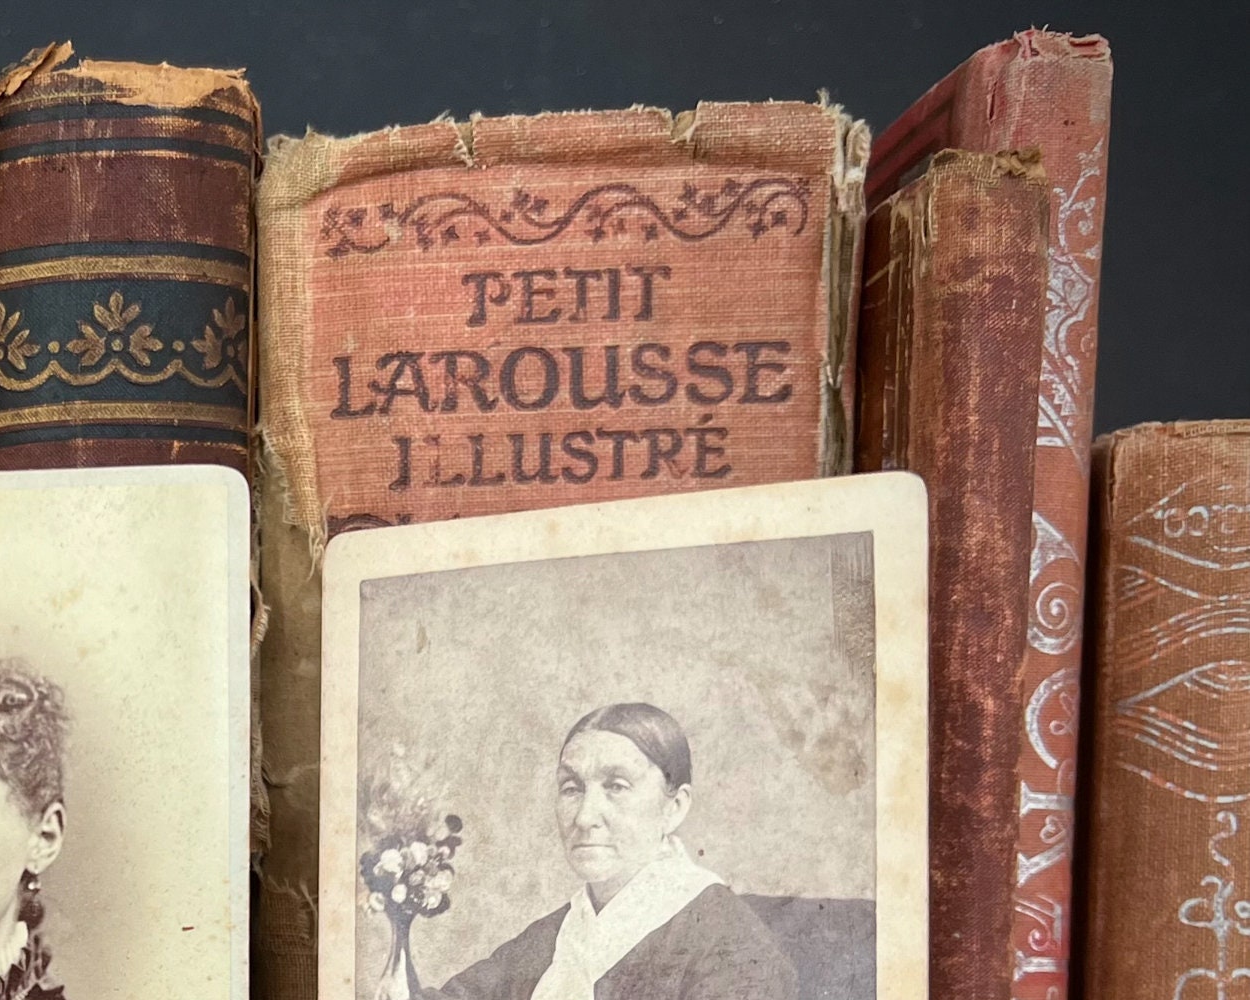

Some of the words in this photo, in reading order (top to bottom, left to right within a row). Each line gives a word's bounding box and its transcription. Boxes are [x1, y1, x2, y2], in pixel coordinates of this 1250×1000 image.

[461, 264, 671, 328] PETIT
[329, 340, 793, 421] LAROUSSE
[388, 413, 732, 492] ILLUSTRÉ
